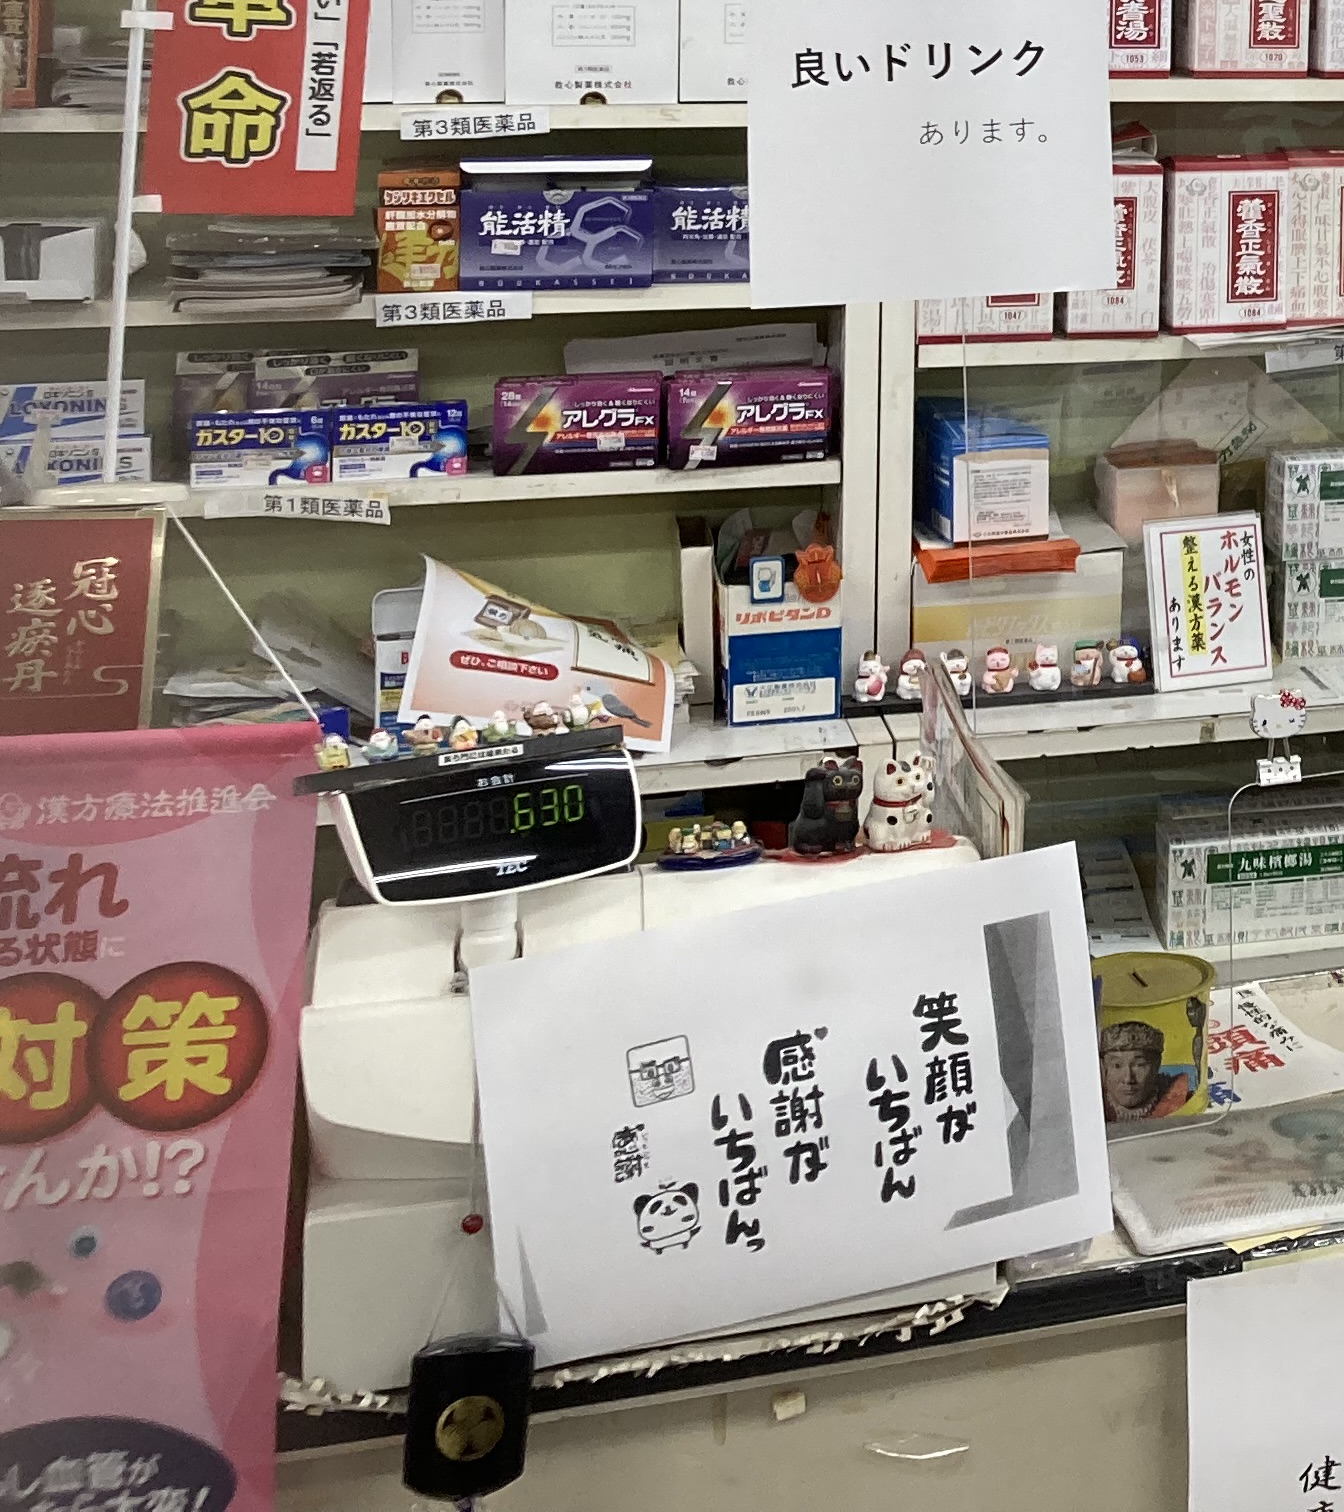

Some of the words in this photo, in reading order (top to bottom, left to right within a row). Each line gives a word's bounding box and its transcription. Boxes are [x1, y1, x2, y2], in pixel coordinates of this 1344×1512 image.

[790, 39, 1047, 89] 良いドリンク
[412, 112, 537, 138] 第3類医薬品
[919, 117, 1049, 146] あります。
[479, 208, 570, 237] 能活精
[381, 299, 507, 324] 第3類医薬品
[263, 494, 385, 520] 第1類医薬品
[1220, 530, 1243, 623] ホルモン
[1238, 531, 1257, 583] 女性の
[735, 605, 832, 625] リポビタンD
[1182, 534, 1207, 654] 整える漢方薬
[1203, 571, 1230, 666] バランス
[1168, 596, 1186, 671] あります
[913, 988, 979, 1146] 笑顔が
[763, 1024, 830, 1186] 感謝が
[863, 1054, 918, 1203] いちばん
